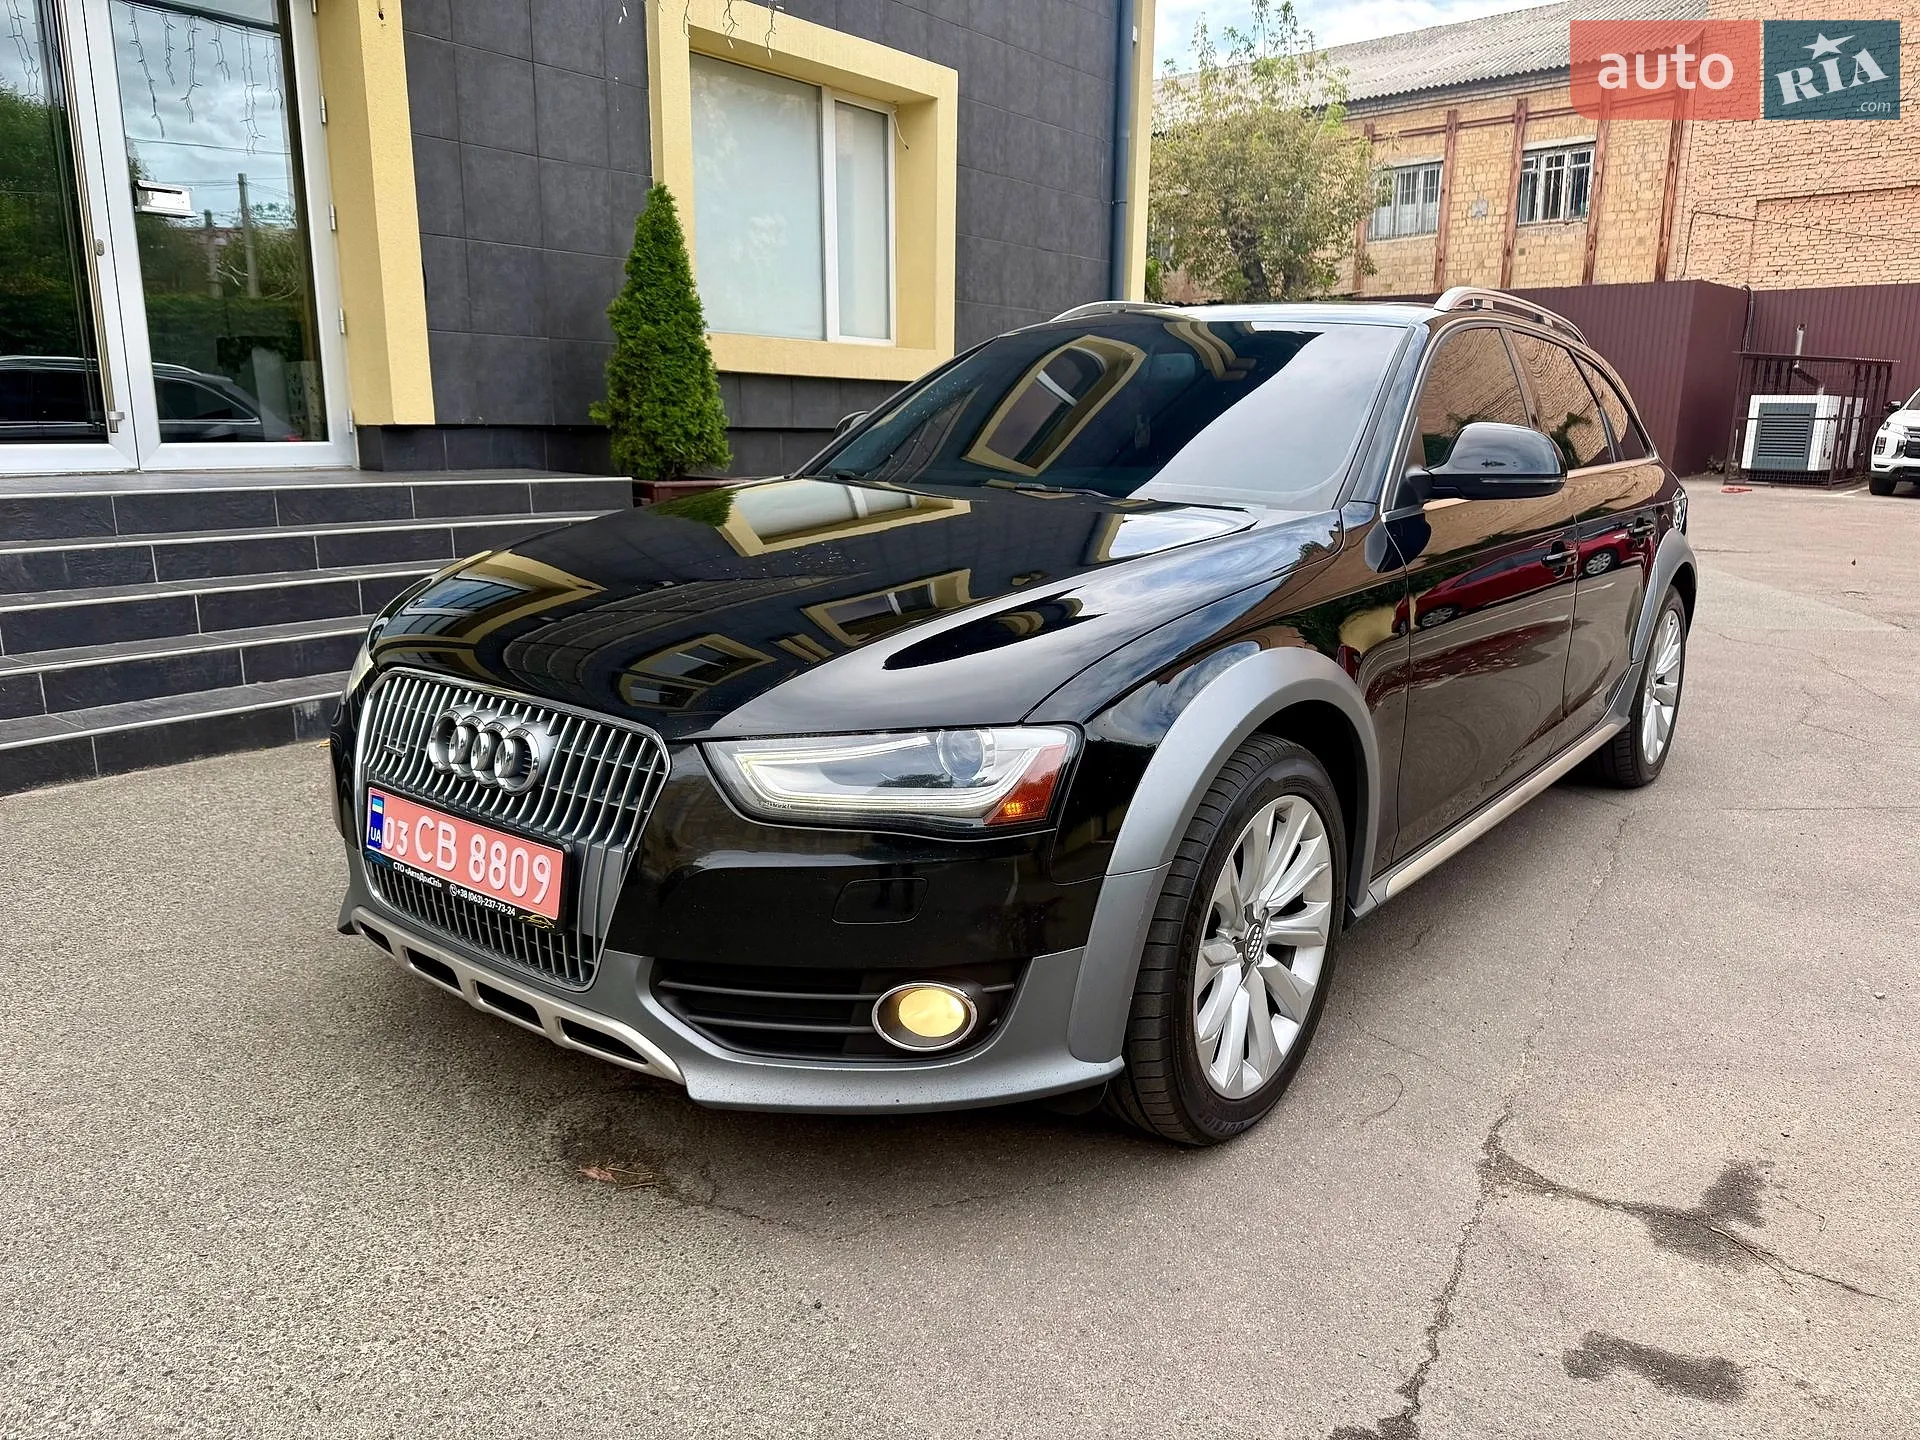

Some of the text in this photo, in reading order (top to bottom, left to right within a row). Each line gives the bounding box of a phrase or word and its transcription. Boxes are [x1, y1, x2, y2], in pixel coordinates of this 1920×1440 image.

[370, 827, 382, 844] UA
[384, 815, 552, 904] 03 CB 8809
